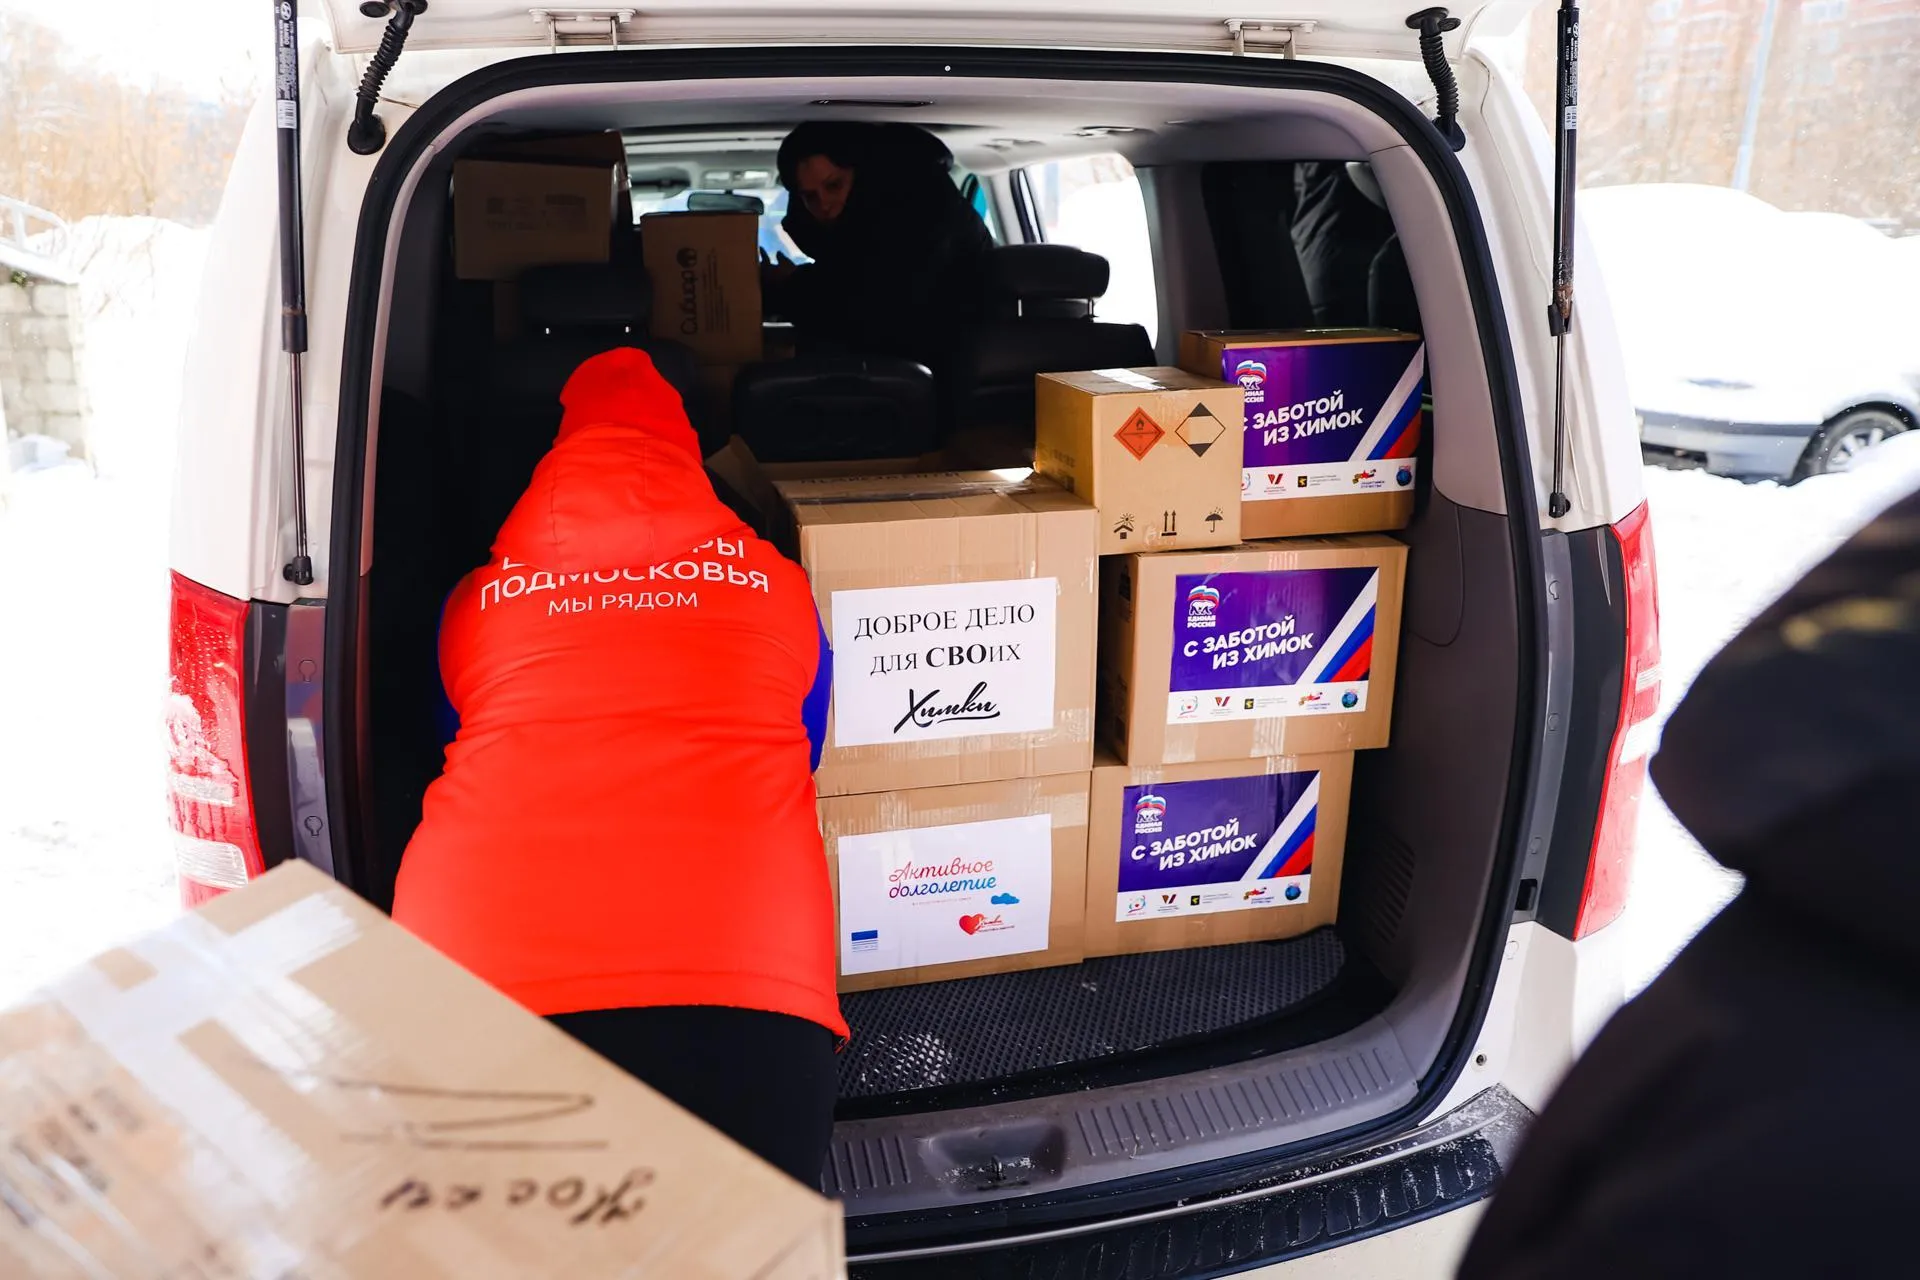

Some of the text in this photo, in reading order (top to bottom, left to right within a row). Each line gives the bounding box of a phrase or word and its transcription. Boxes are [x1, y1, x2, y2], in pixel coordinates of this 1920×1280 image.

[1252, 389, 1344, 431] ЗАБОТОЙ
[1263, 424, 1290, 446] ИЗ
[1293, 408, 1363, 440] ХИМОК
[548, 591, 698, 617] МЫ РЯДОМ
[854, 603, 1035, 641] ДОБРОЕ ДЕЛО
[1183, 614, 1296, 657] С ЗАБОТОЙ
[1212, 633, 1314, 670] ИЗ ХИМОК
[893, 681, 1001, 734] Химки
[1131, 817, 1240, 861] С ЗАБОТОЙ
[1159, 833, 1258, 871] ИЗ ХИМОК
[888, 857, 993, 883] Активное
[889, 876, 997, 898] долголетие
